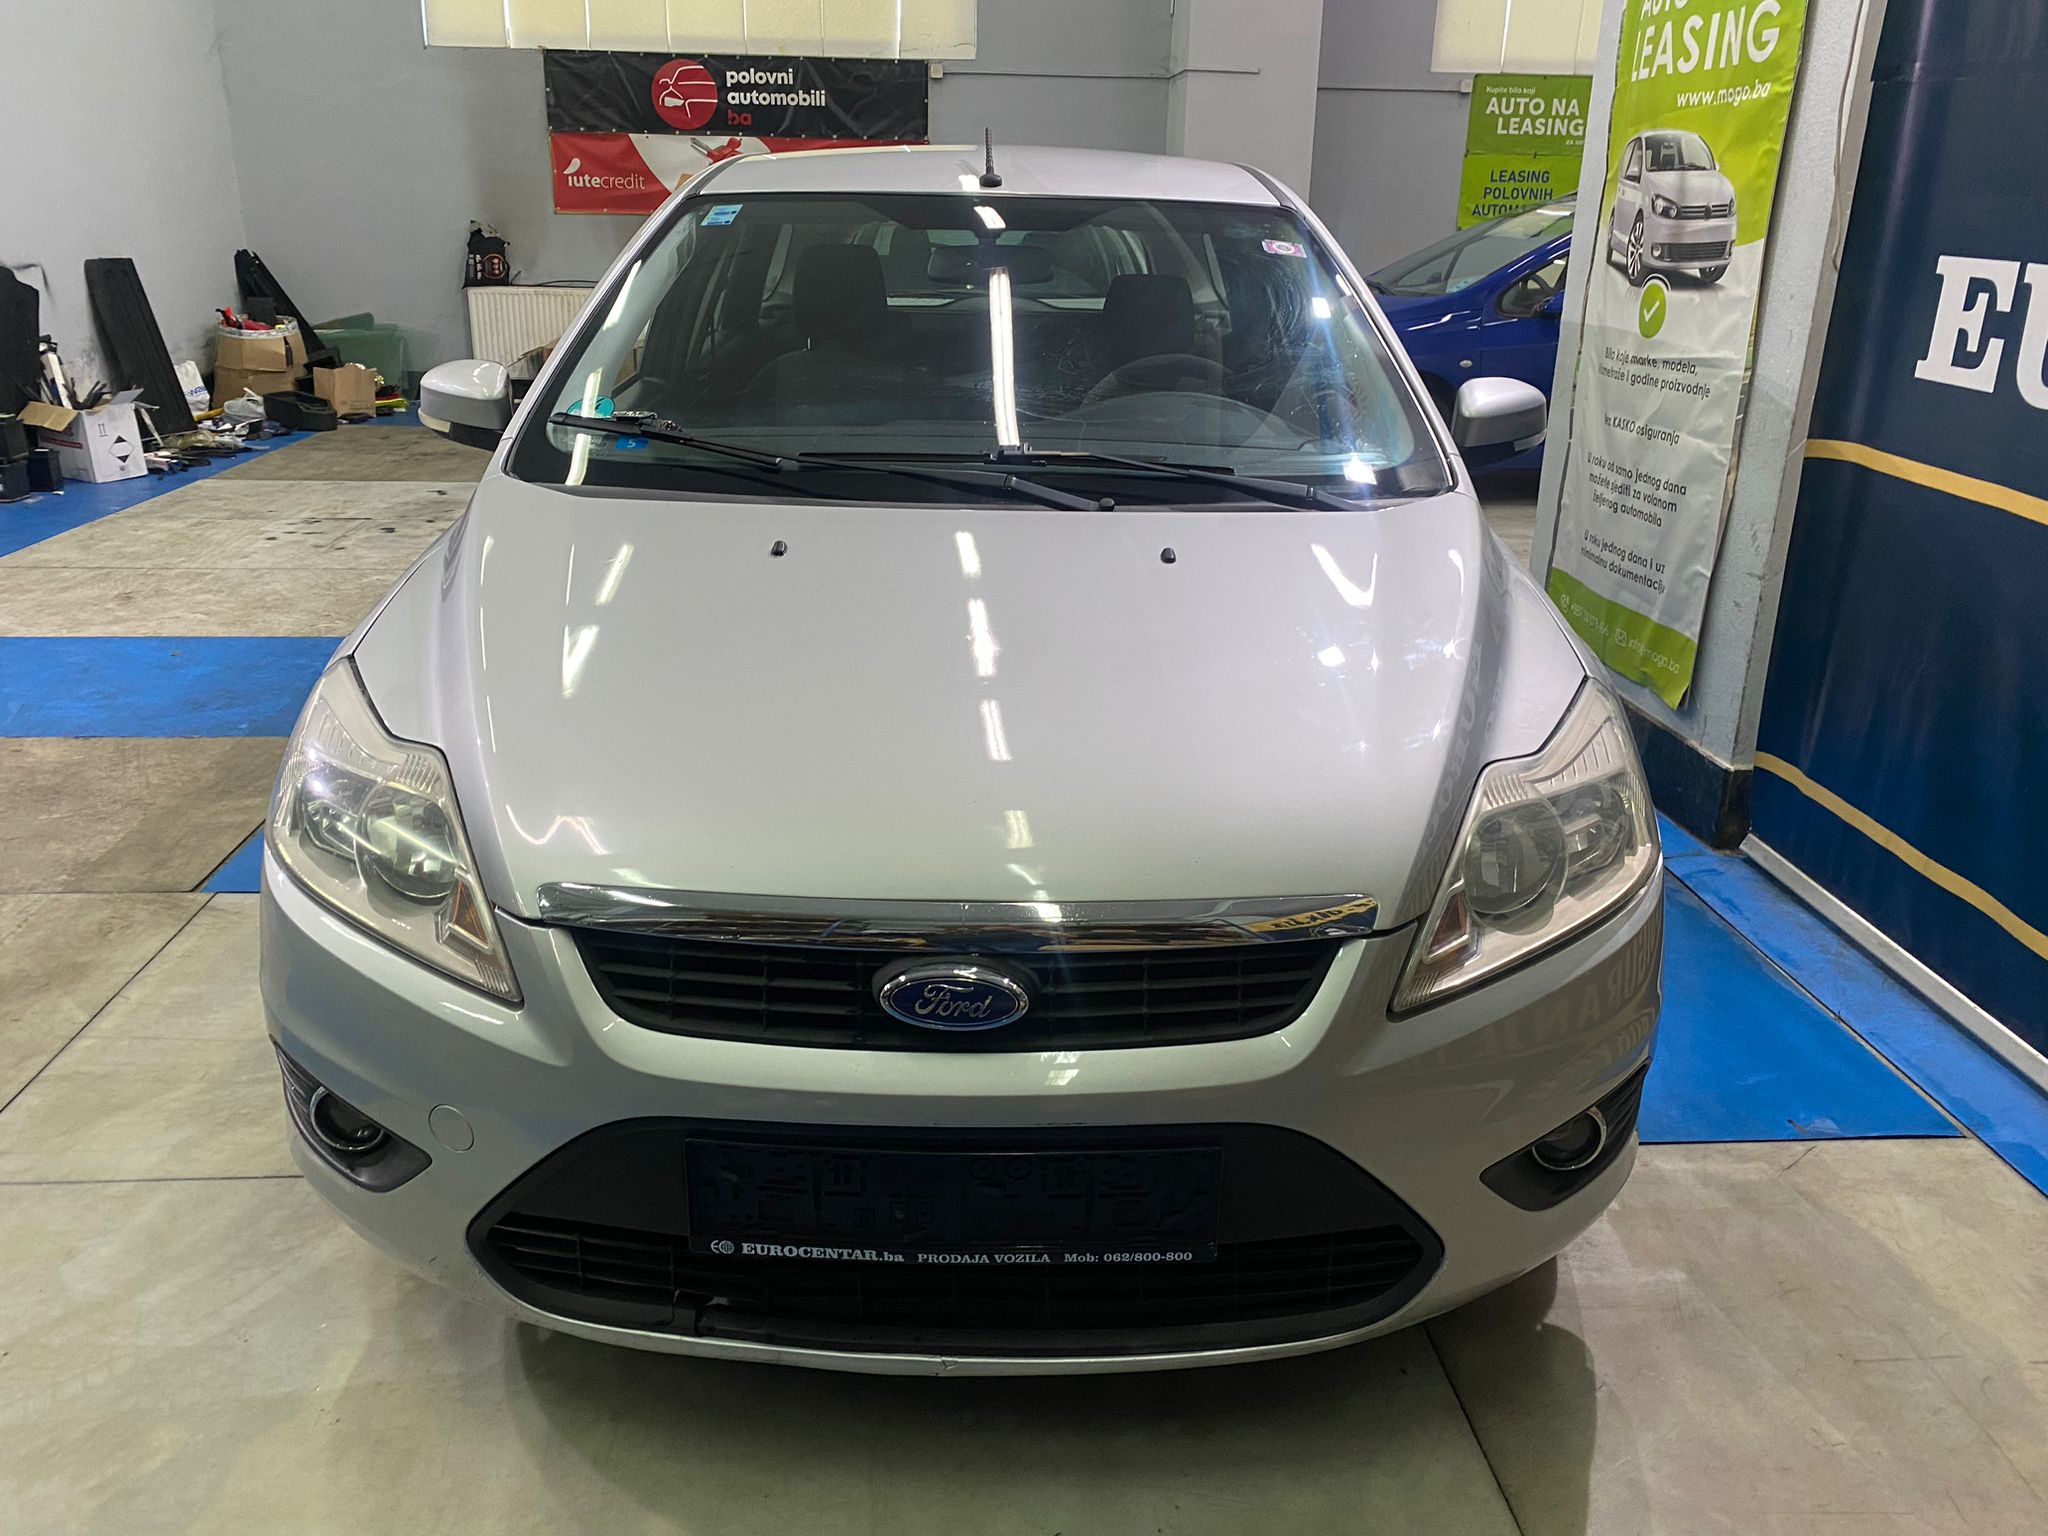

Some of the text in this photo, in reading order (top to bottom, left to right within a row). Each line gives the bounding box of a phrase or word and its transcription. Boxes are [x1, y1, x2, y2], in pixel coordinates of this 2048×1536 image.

[1631, 0, 1782, 82] LEASING
[726, 68, 794, 87] polovni
[727, 89, 826, 107] automobili
[1677, 79, 1772, 107] www.mogo.ba
[1485, 97, 1580, 116] AUTO NA
[1497, 117, 1584, 136] LEASING
[568, 173, 645, 190] iutecredit
[1490, 169, 1550, 183] LEASING
[1483, 186, 1553, 200] POLOVNIH
[1630, 354, 1660, 370] marke,
[1662, 359, 1698, 376] modela,
[1630, 372, 1659, 388] godine
[1660, 378, 1711, 400] proizvodnje
[1612, 416, 1636, 433] KASKO
[1636, 424, 1680, 446] osiguranja
[1615, 465, 1633, 479] samo
[1634, 468, 1661, 491] jednog
[1662, 478, 1687, 496] dana
[1632, 489, 1641, 500] za
[1642, 492, 1677, 512] volanom
[1620, 504, 1662, 527] automobila
[1600, 538, 1627, 562] jednog
[1627, 550, 1648, 568] dana
[1655, 562, 1666, 574] uz
[914, 983, 993, 1018] Ford
[741, 1242, 1193, 1264] EUROCENTAR.ba PRODAJA VOZILA Mob: 062/800-800
